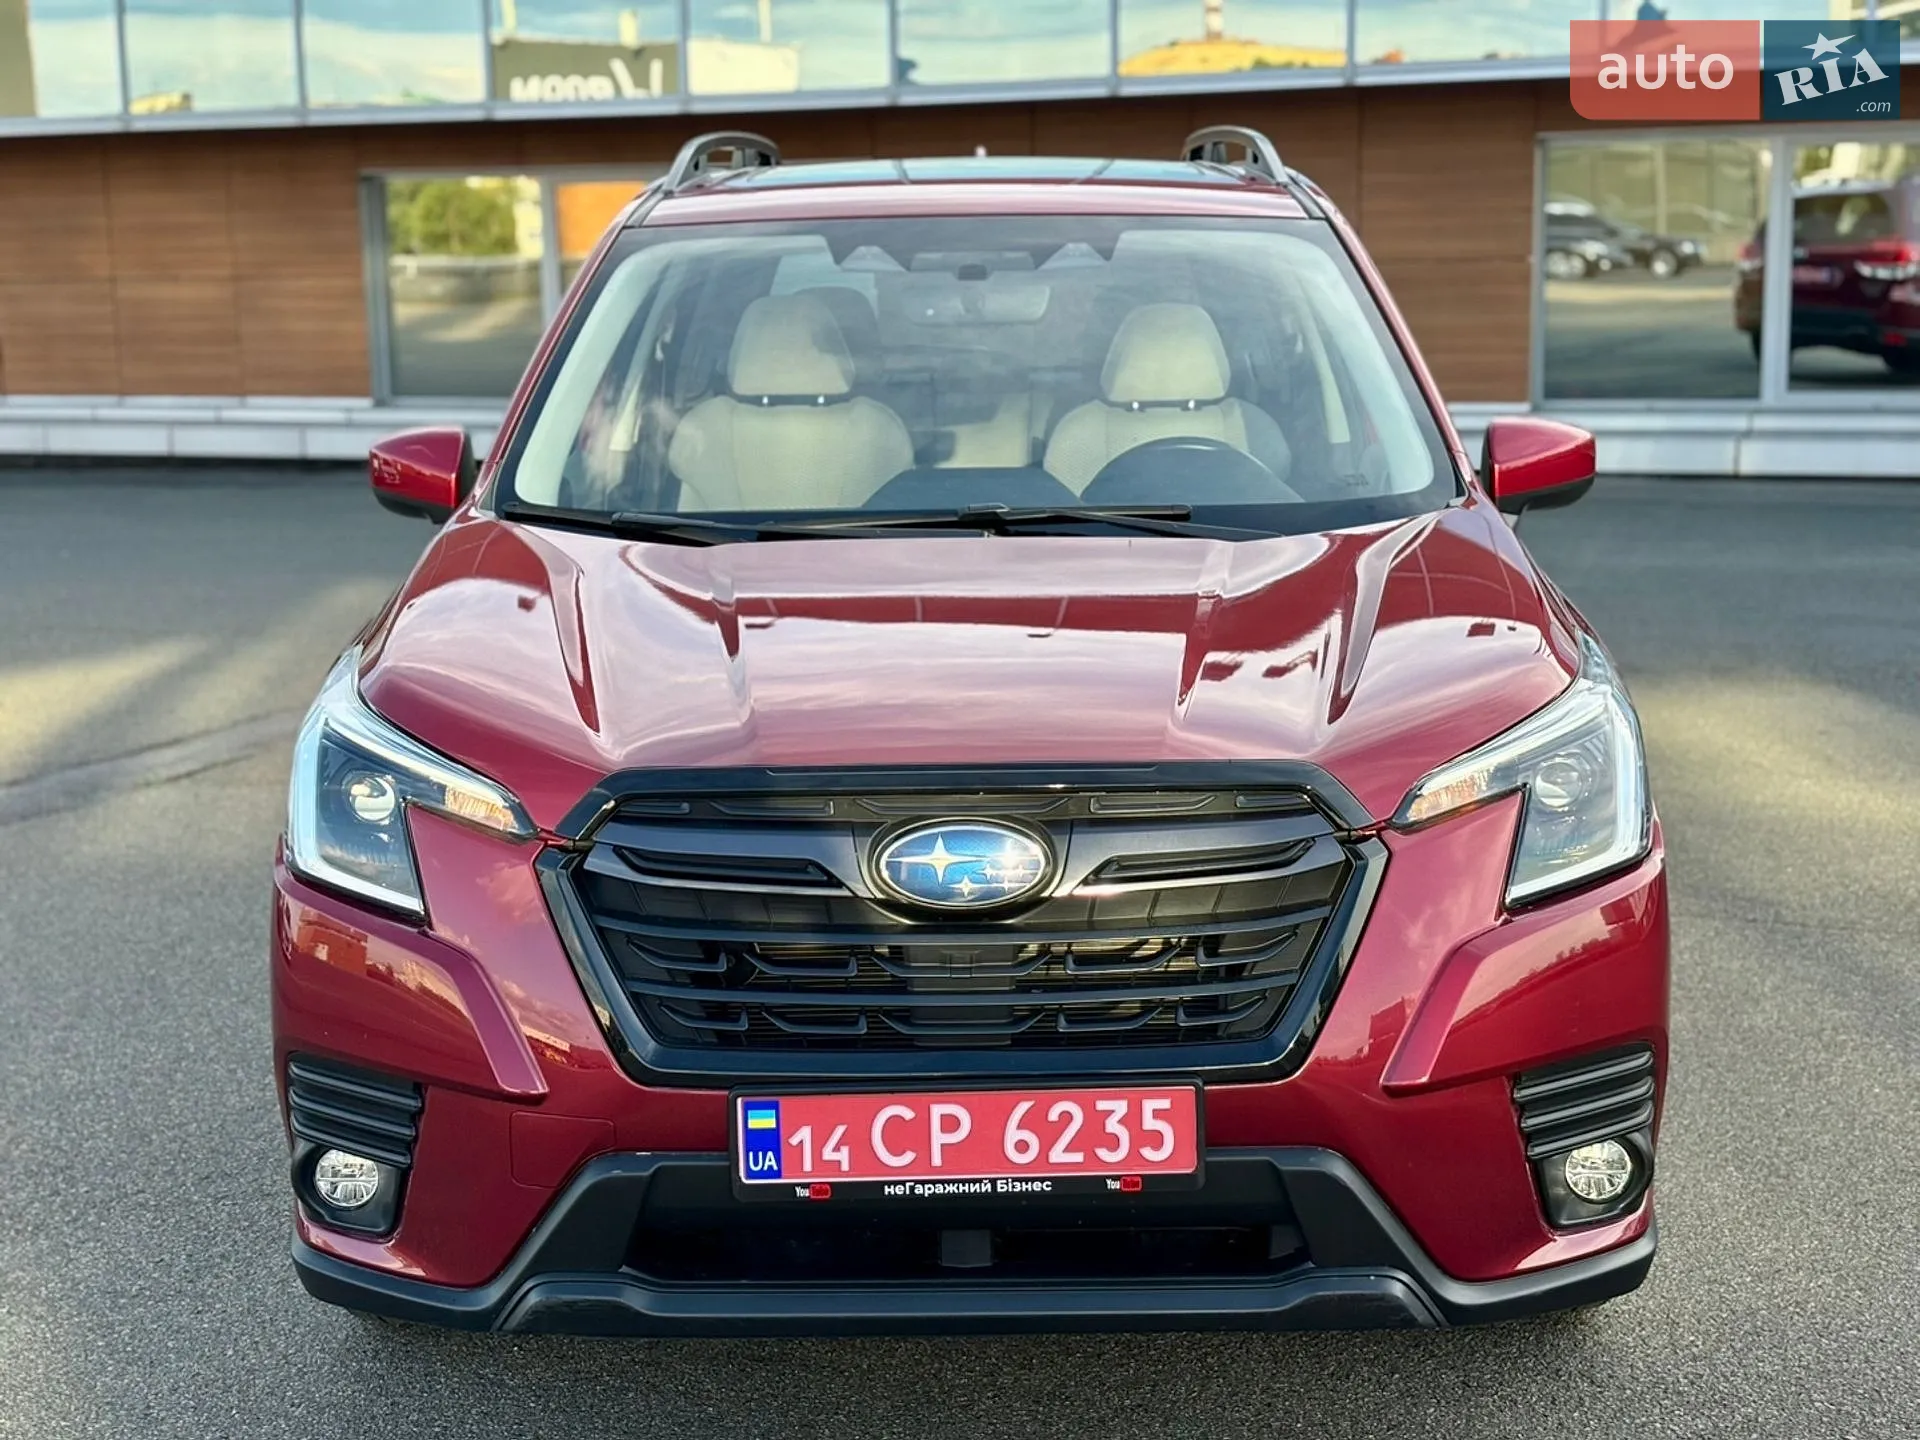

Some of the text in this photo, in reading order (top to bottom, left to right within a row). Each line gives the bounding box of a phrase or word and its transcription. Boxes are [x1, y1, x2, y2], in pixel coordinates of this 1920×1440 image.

[787, 1098, 1176, 1173] 14 CP 6235
[748, 1150, 778, 1172] UA
[884, 1178, 1053, 1197] неГаражний Бізнес
